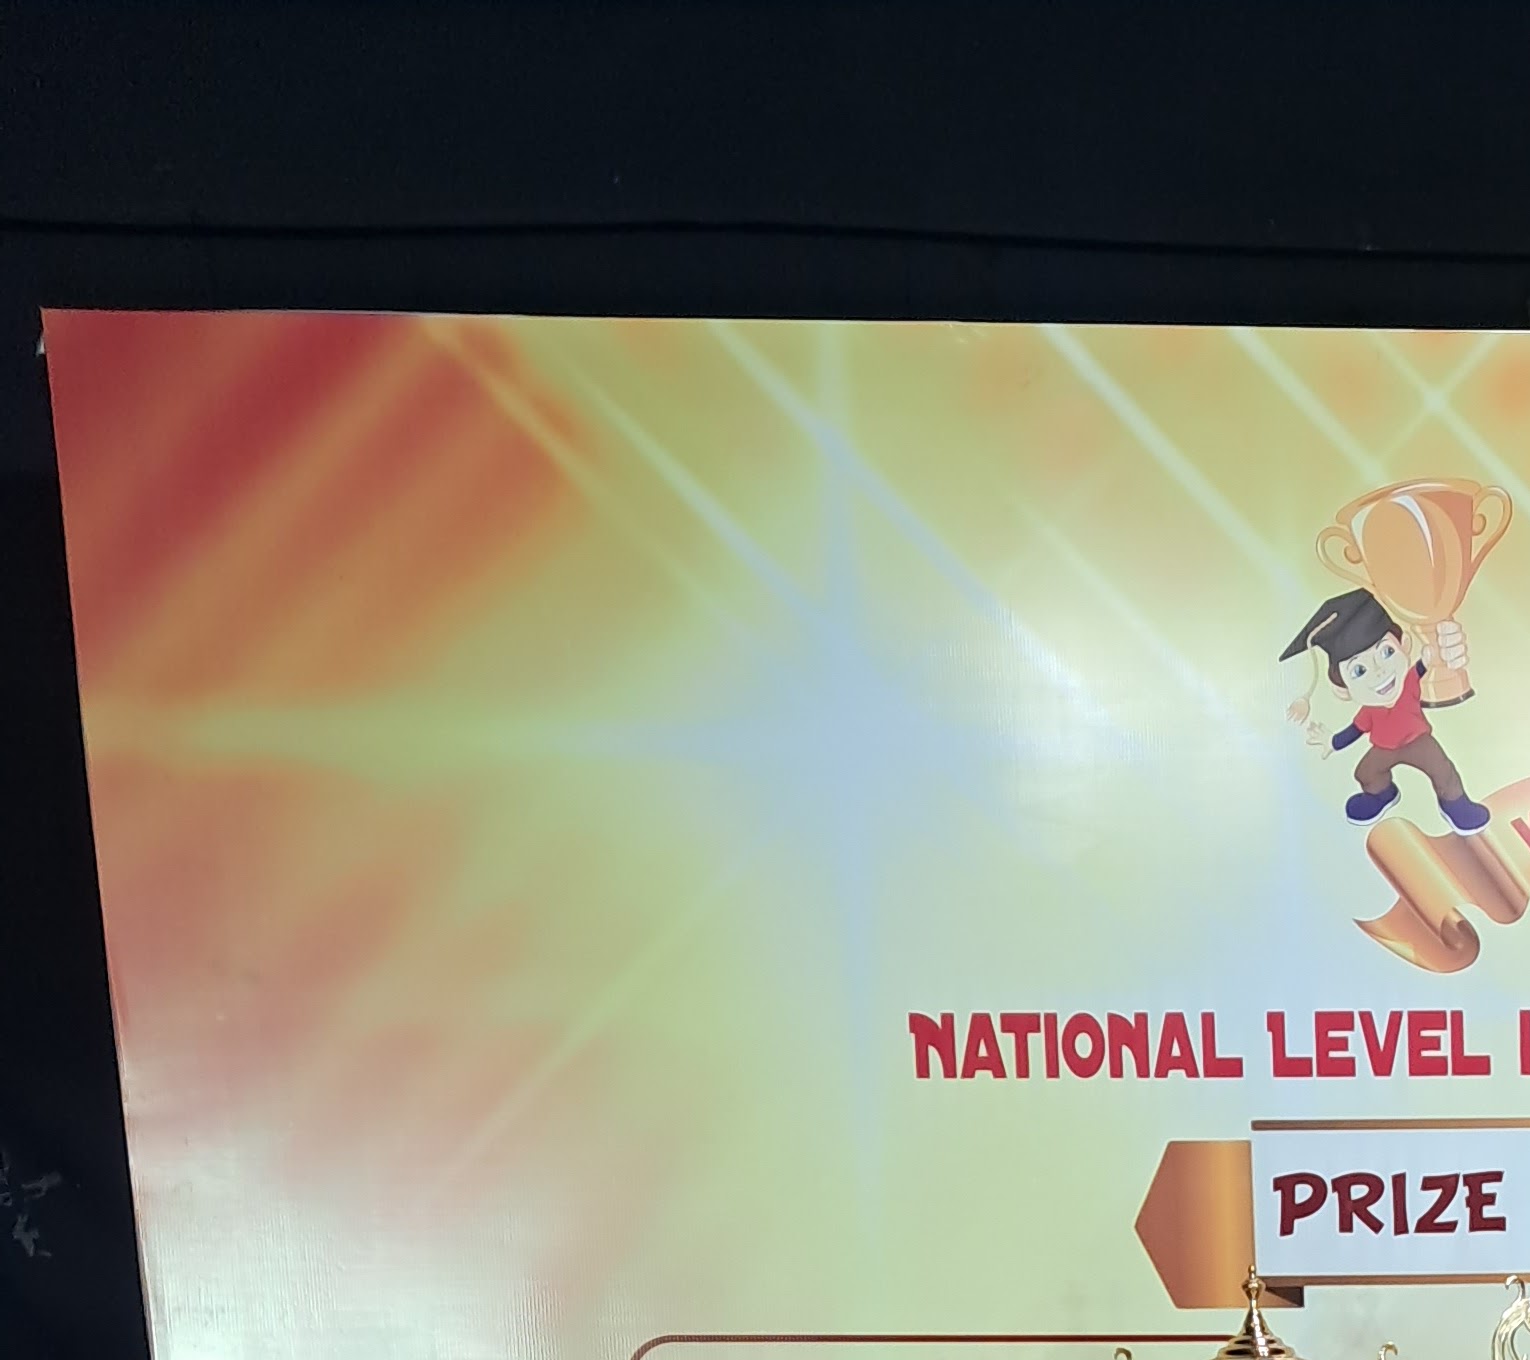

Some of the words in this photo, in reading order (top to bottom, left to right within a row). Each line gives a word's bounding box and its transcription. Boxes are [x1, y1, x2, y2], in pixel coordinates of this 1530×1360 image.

[908, 1011, 1243, 1079] NATIONAL
[1266, 1009, 1491, 1078] LEVEL
[1272, 1170, 1507, 1236] PRIZE
